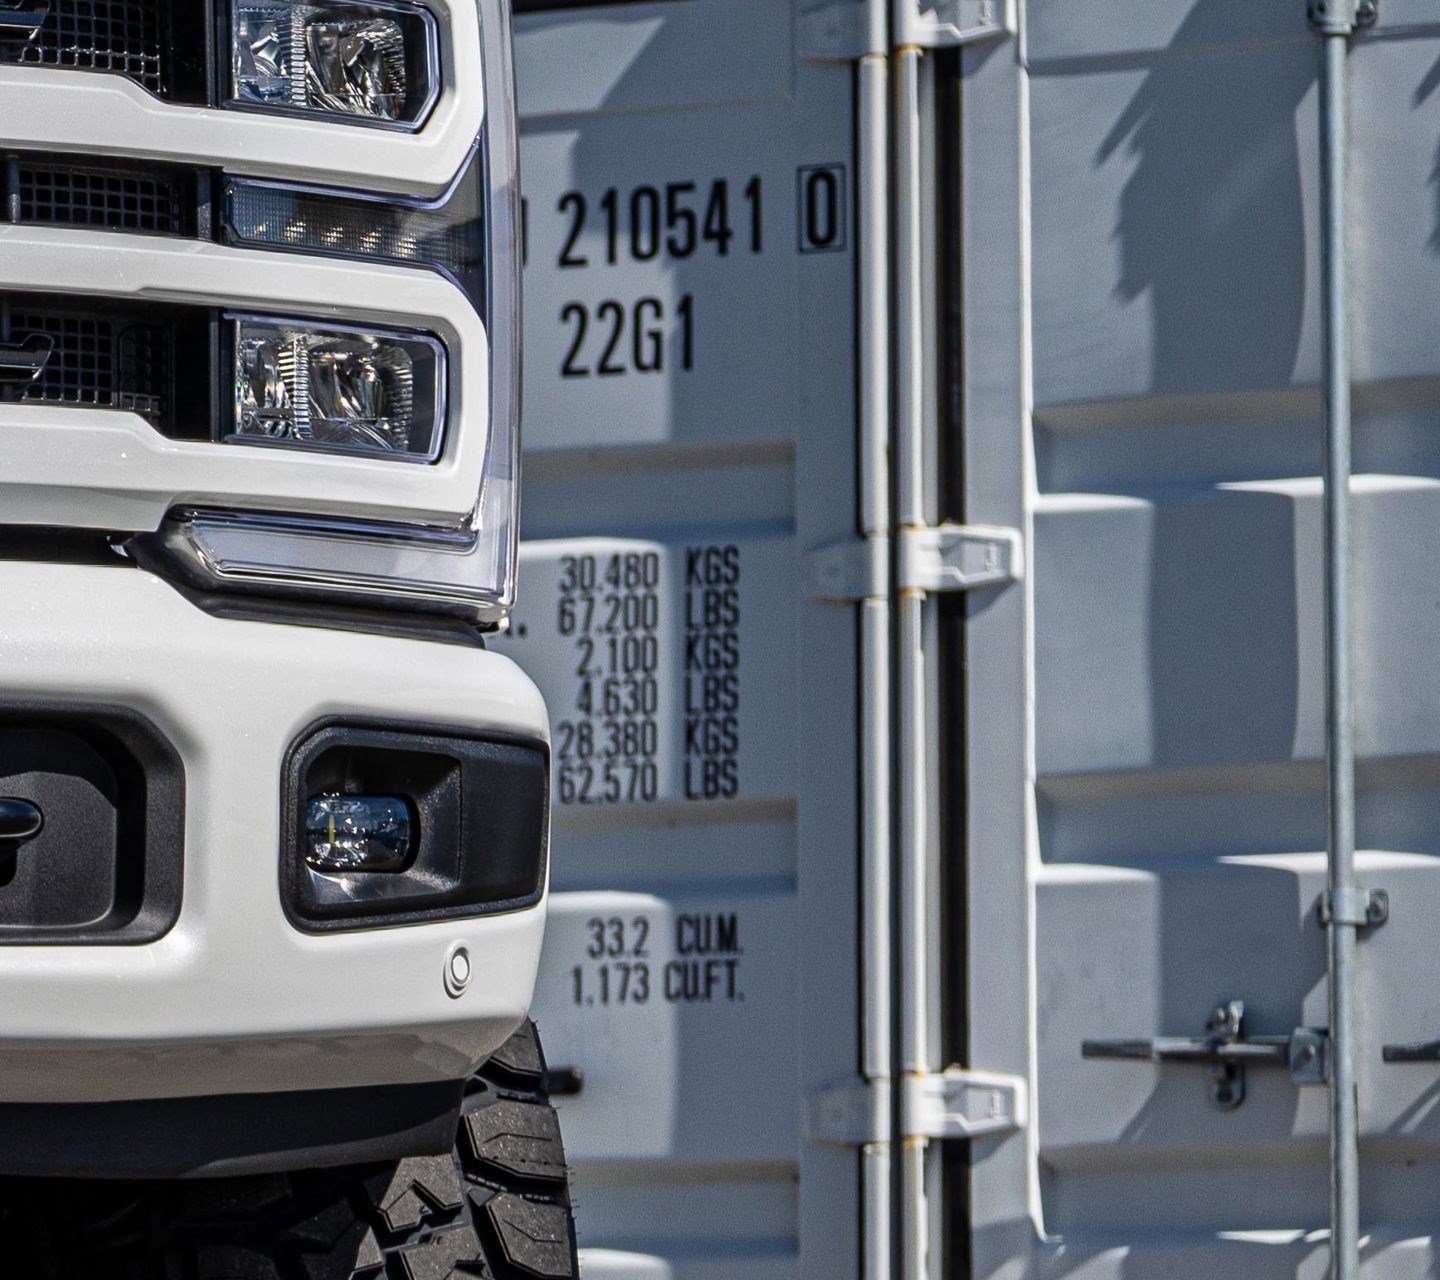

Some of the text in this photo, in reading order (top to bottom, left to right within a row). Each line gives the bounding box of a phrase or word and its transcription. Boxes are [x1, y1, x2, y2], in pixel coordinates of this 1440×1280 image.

[556, 174, 763, 269] 210541
[559, 292, 694, 379] 22G1
[559, 545, 740, 593] 30.480 KGS
[558, 593, 659, 635] 67.200
[684, 589, 740, 628] LBS
[576, 632, 740, 676] 2.100 KGS
[684, 674, 740, 716] LBS
[557, 718, 740, 760] 28.380 KGS
[558, 759, 739, 805] 62.570 LBS
[572, 960, 650, 1007] 1.173
